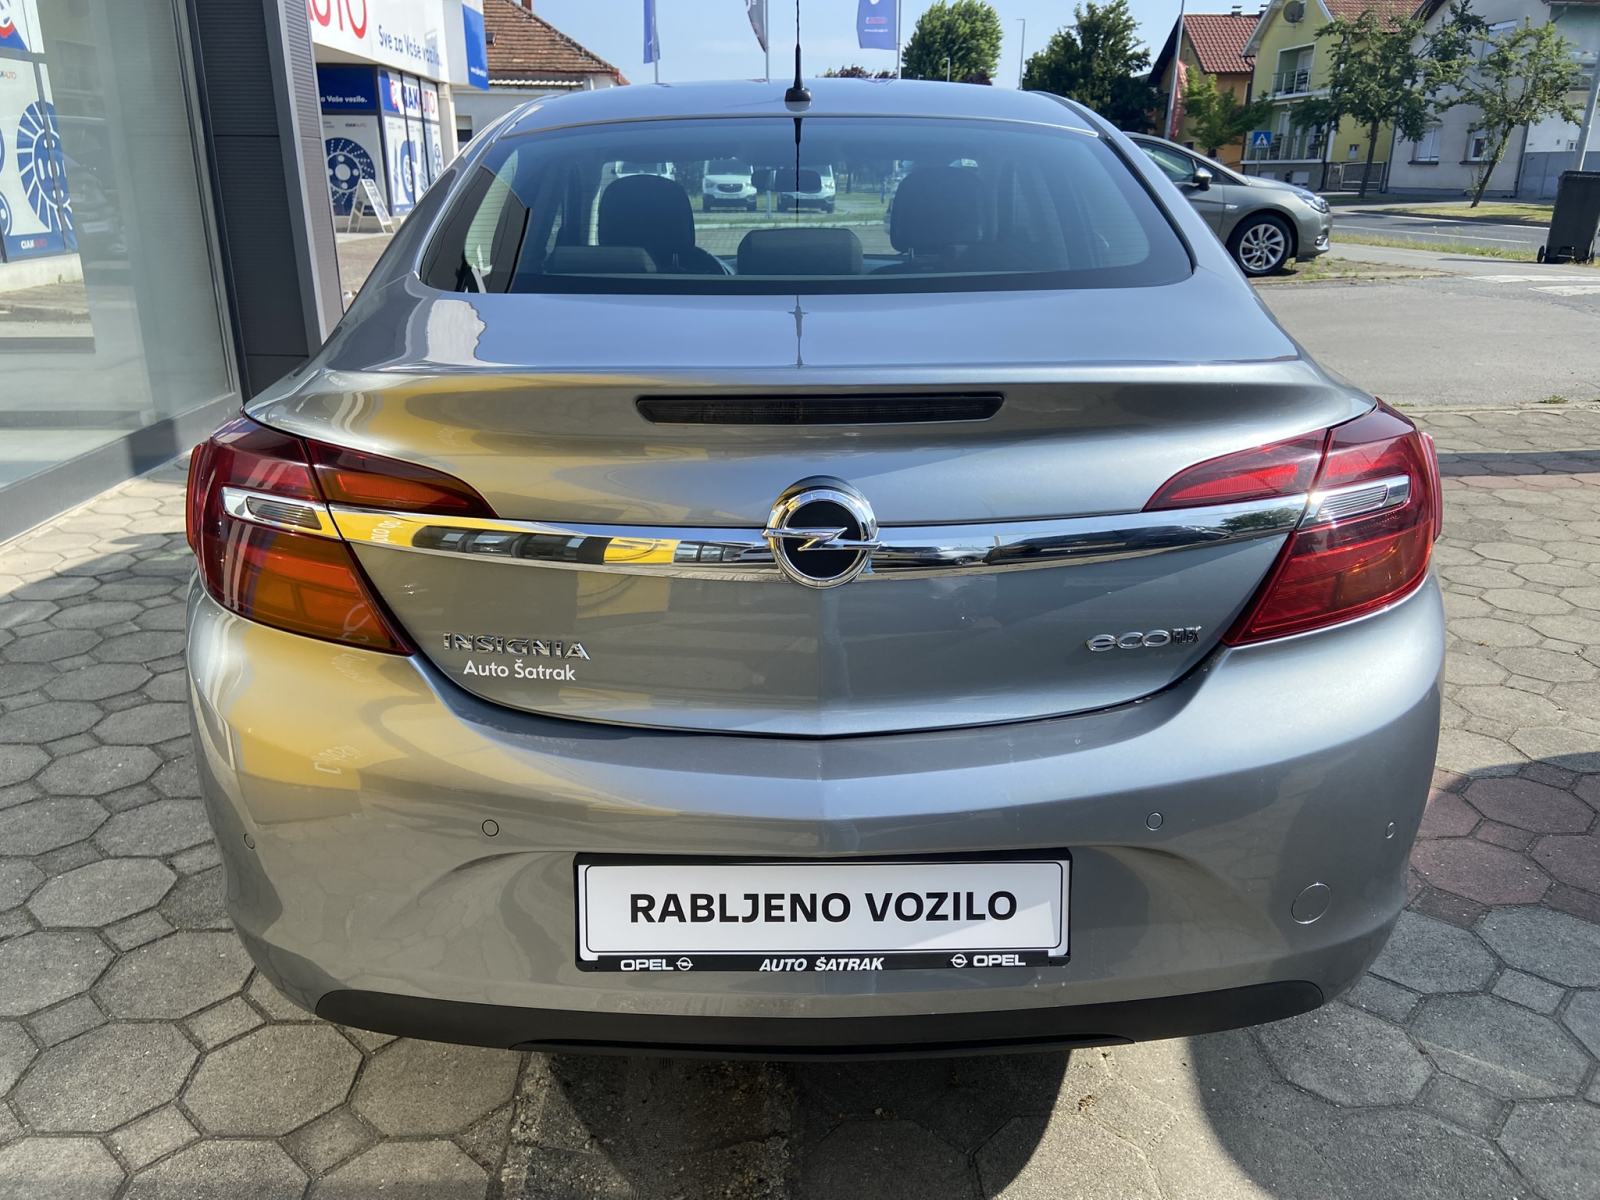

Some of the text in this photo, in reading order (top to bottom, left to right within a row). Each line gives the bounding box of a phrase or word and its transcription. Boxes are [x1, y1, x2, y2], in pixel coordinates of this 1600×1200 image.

[306, 0, 367, 38] UTO
[378, 24, 392, 48] Sve
[394, 36, 403, 53] za
[442, 633, 591, 660] INSIGNIA
[463, 658, 577, 682] Auto Šatrak
[629, 890, 1018, 924] RABLJENO VOZILO
[620, 958, 673, 972] OPEL
[759, 956, 885, 972] AUTO ŠATRAK
[973, 954, 1026, 967] OPEL
